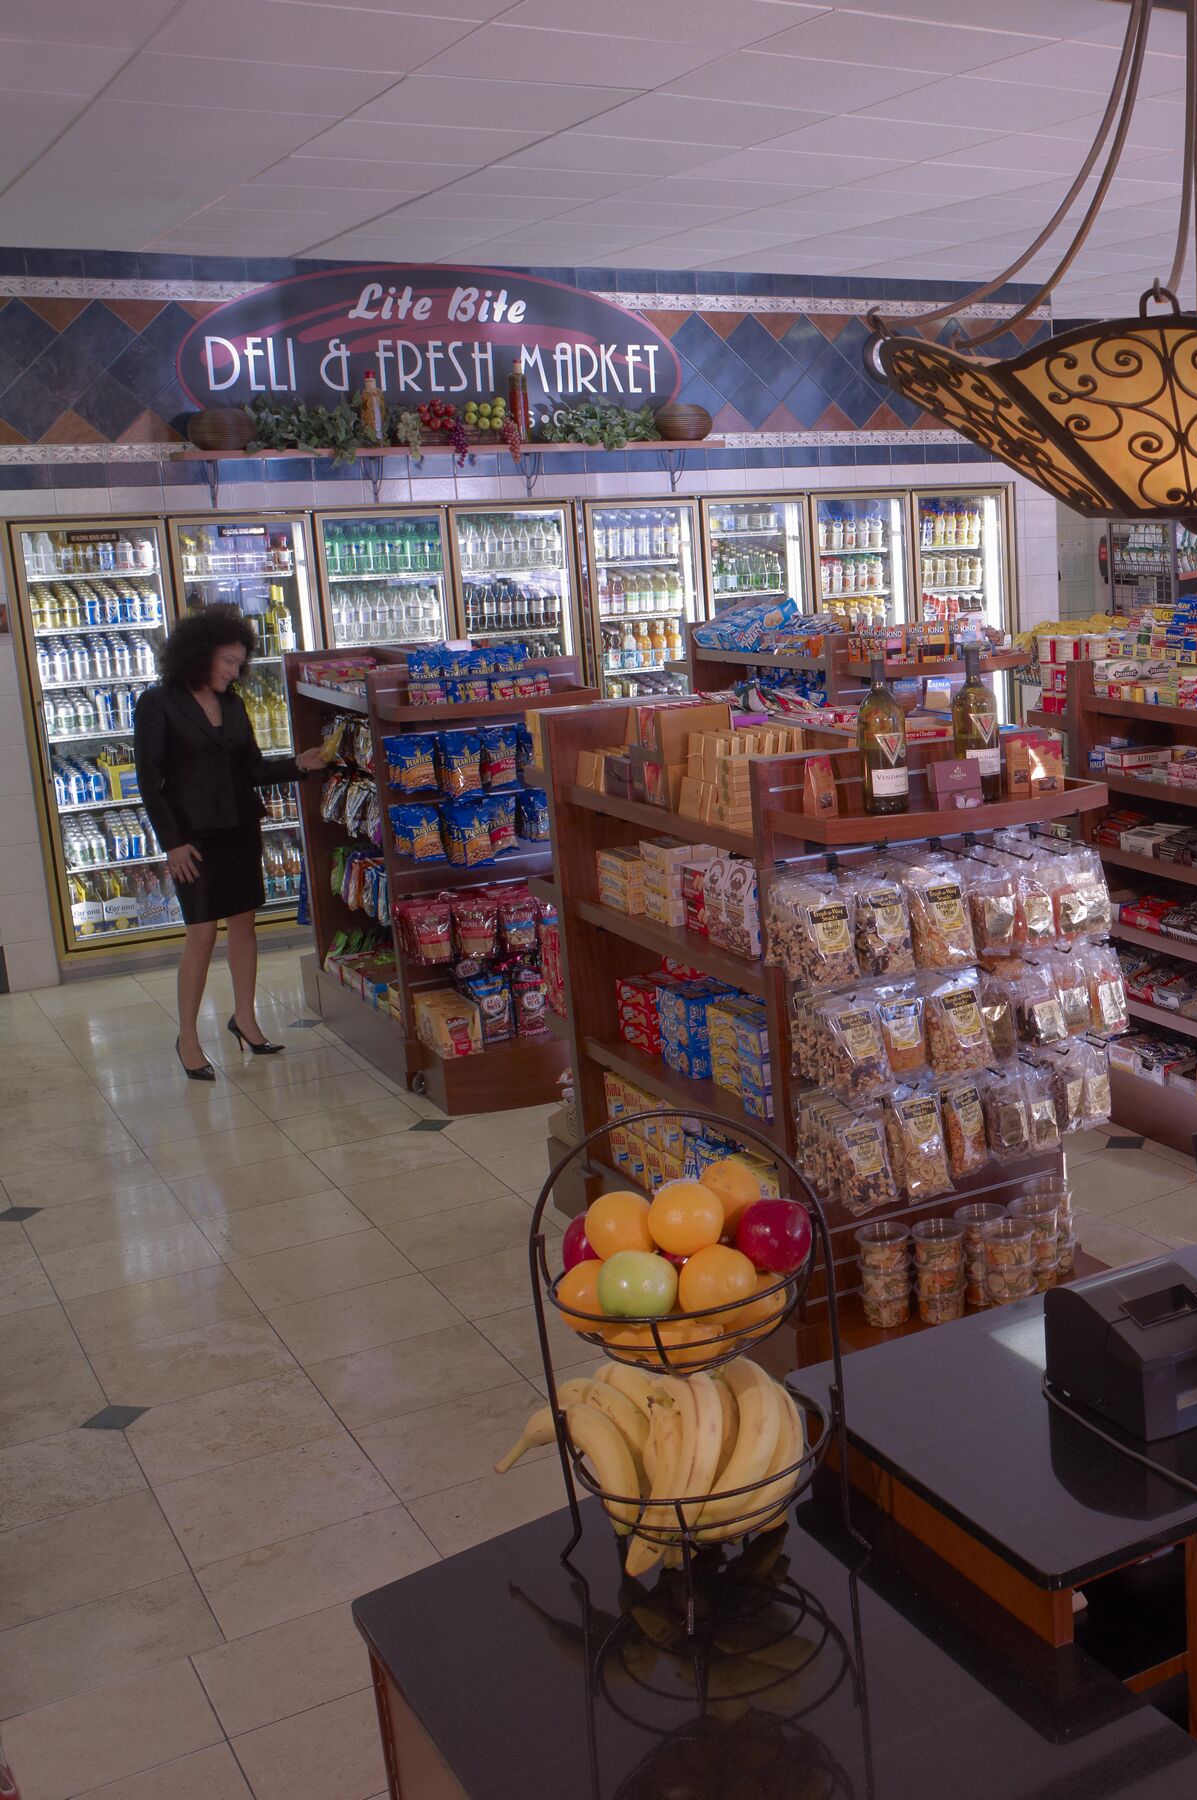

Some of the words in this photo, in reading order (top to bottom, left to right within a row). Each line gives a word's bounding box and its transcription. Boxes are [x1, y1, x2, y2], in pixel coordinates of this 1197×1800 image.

[348, 282, 432, 321] Lite
[447, 286, 527, 324] Bite
[204, 336, 297, 391] DELI
[320, 338, 351, 391] &
[376, 340, 495, 392] FRESH
[520, 342, 659, 394] MARKET
[886, 630, 902, 638] KIND
[909, 626, 924, 634] KIND
[927, 626, 945, 634] KIND
[960, 624, 977, 632] KIND
[406, 754, 432, 768] PLANTERS
[454, 753, 481, 767] PLANTERS
[1137, 754, 1160, 763] ALTOIDS
[413, 823, 439, 837] PLANTERS
[105, 904, 135, 913] Corona
[936, 902, 958, 910] Dragon
[942, 908, 955, 916] Mix
[822, 924, 841, 932] Health
[952, 1007, 973, 1016] Dragon
[606, 1083, 621, 1097] Nilla
[623, 1093, 638, 1106] Nilla
[610, 1132, 626, 1145] Nilla
[628, 1141, 642, 1156] Nilla
[647, 1153, 660, 1167] Nilla
[664, 1164, 678, 1178] Nilla
